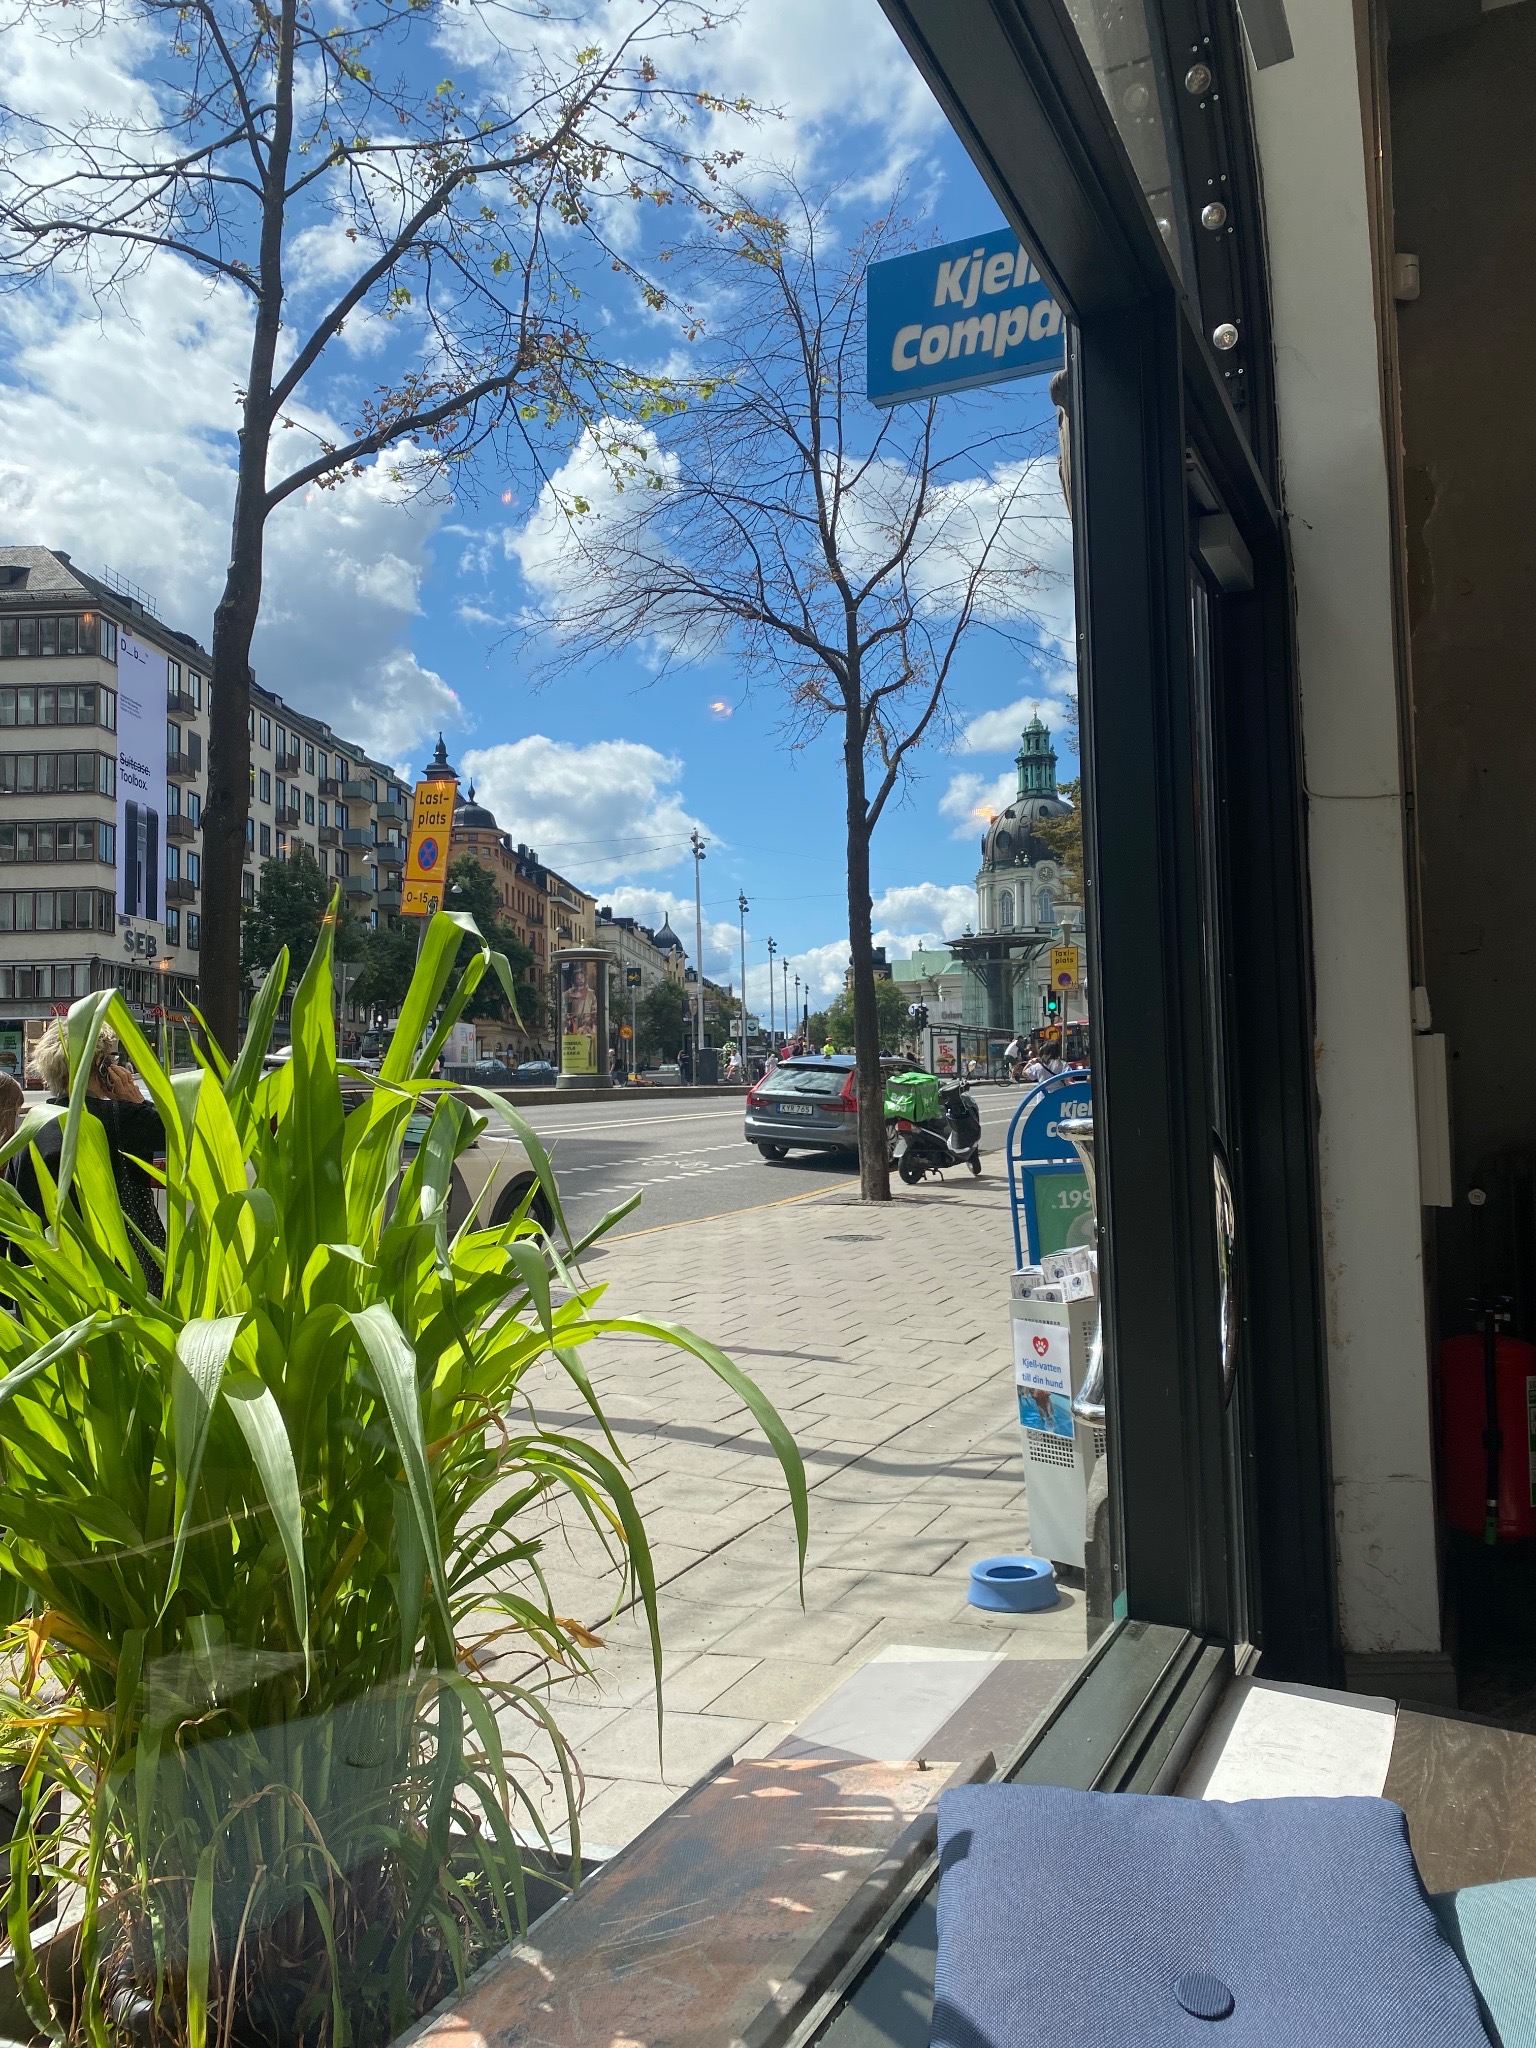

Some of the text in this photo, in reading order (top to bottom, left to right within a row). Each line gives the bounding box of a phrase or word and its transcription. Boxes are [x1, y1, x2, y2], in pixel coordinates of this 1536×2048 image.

[891, 299, 1066, 372] Compa
[119, 768, 148, 790] Toolbox.
[419, 790, 449, 805] Last-
[418, 811, 446, 828] plats
[406, 892, 428, 903] 0-15
[123, 930, 157, 957] SEB
[1055, 957, 1074, 965] plats
[797, 1105, 810, 1114] 765
[1046, 1121, 1060, 1138] C
[1058, 1189, 1092, 1210] 199
[1022, 1358, 1062, 1373] Kjell-vatten
[1022, 1373, 1063, 1389] till din hund
